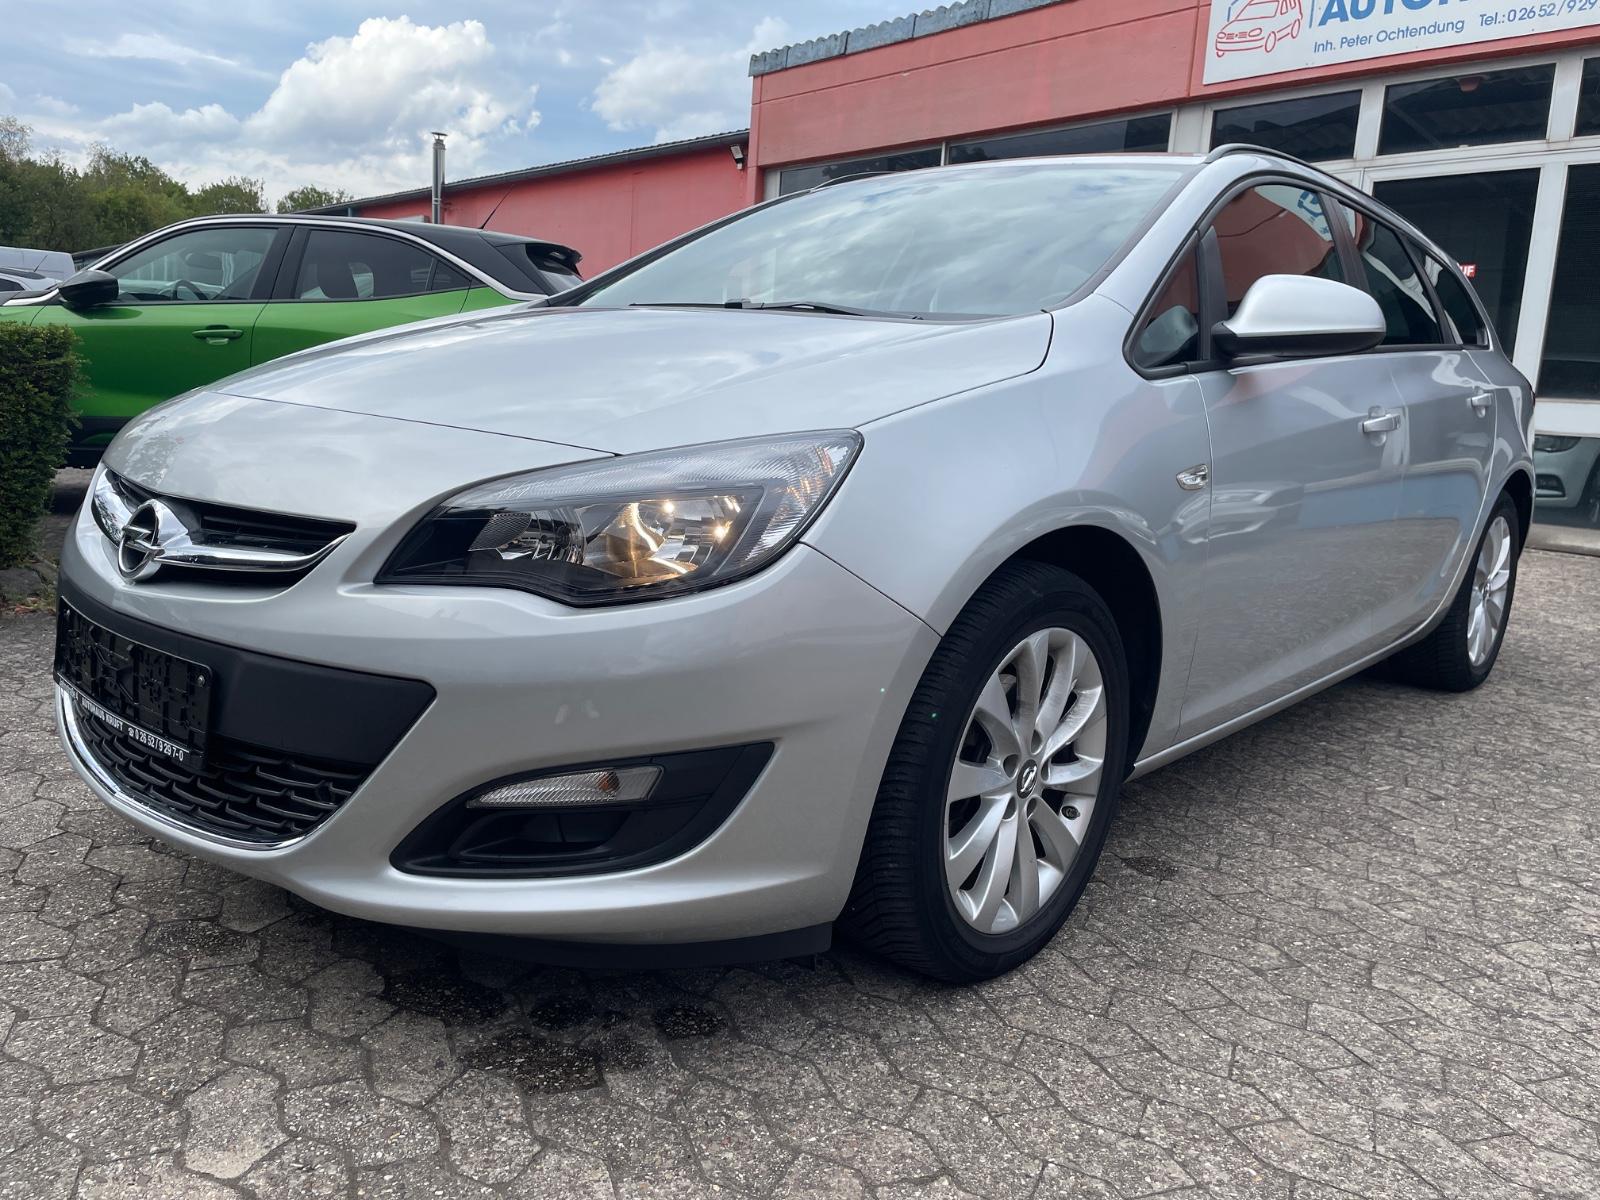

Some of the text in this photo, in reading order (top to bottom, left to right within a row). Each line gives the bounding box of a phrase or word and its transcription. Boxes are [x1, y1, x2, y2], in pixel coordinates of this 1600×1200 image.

[1313, 40, 1336, 53] Inh.
[1340, 35, 1373, 49] Peter
[1376, 21, 1465, 43] Ochtendung
